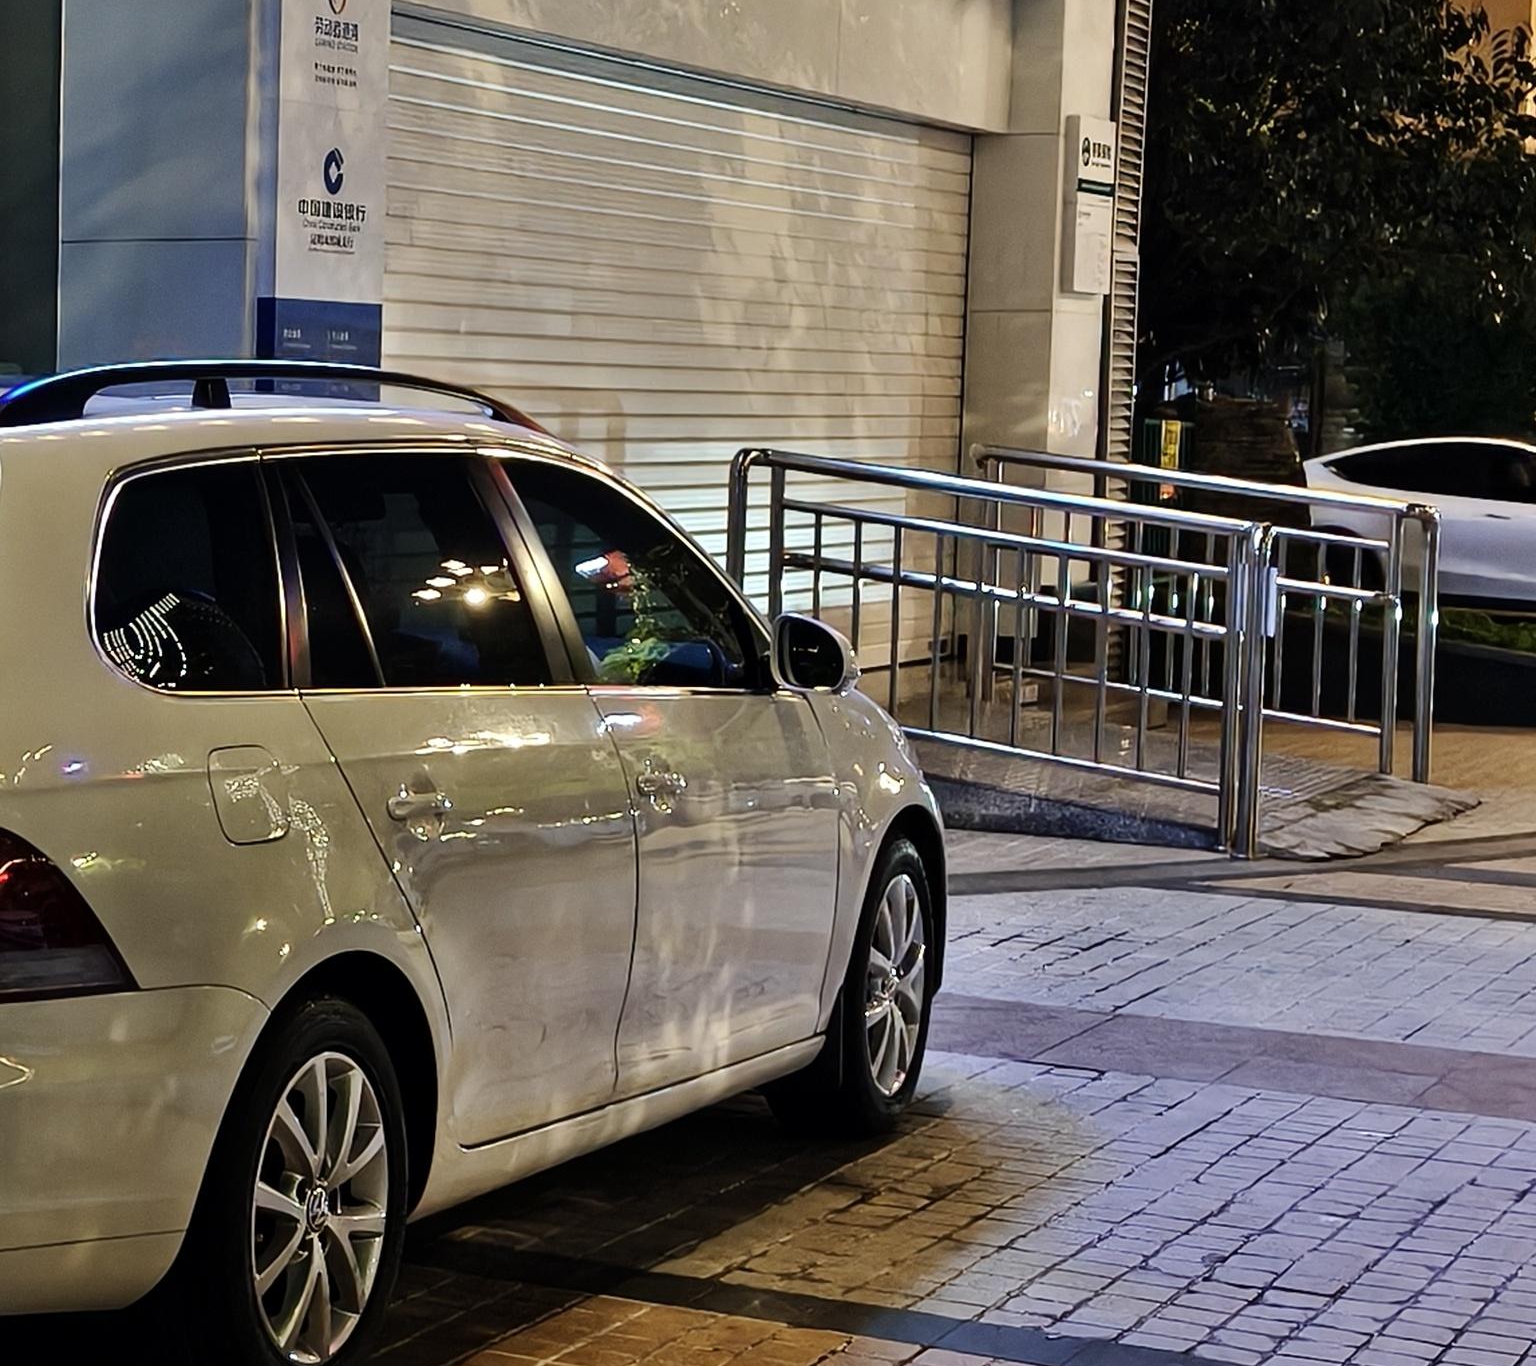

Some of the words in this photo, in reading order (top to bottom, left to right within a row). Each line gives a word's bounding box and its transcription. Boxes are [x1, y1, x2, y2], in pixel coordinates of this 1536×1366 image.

[298, 198, 367, 223] 中国建设银行
